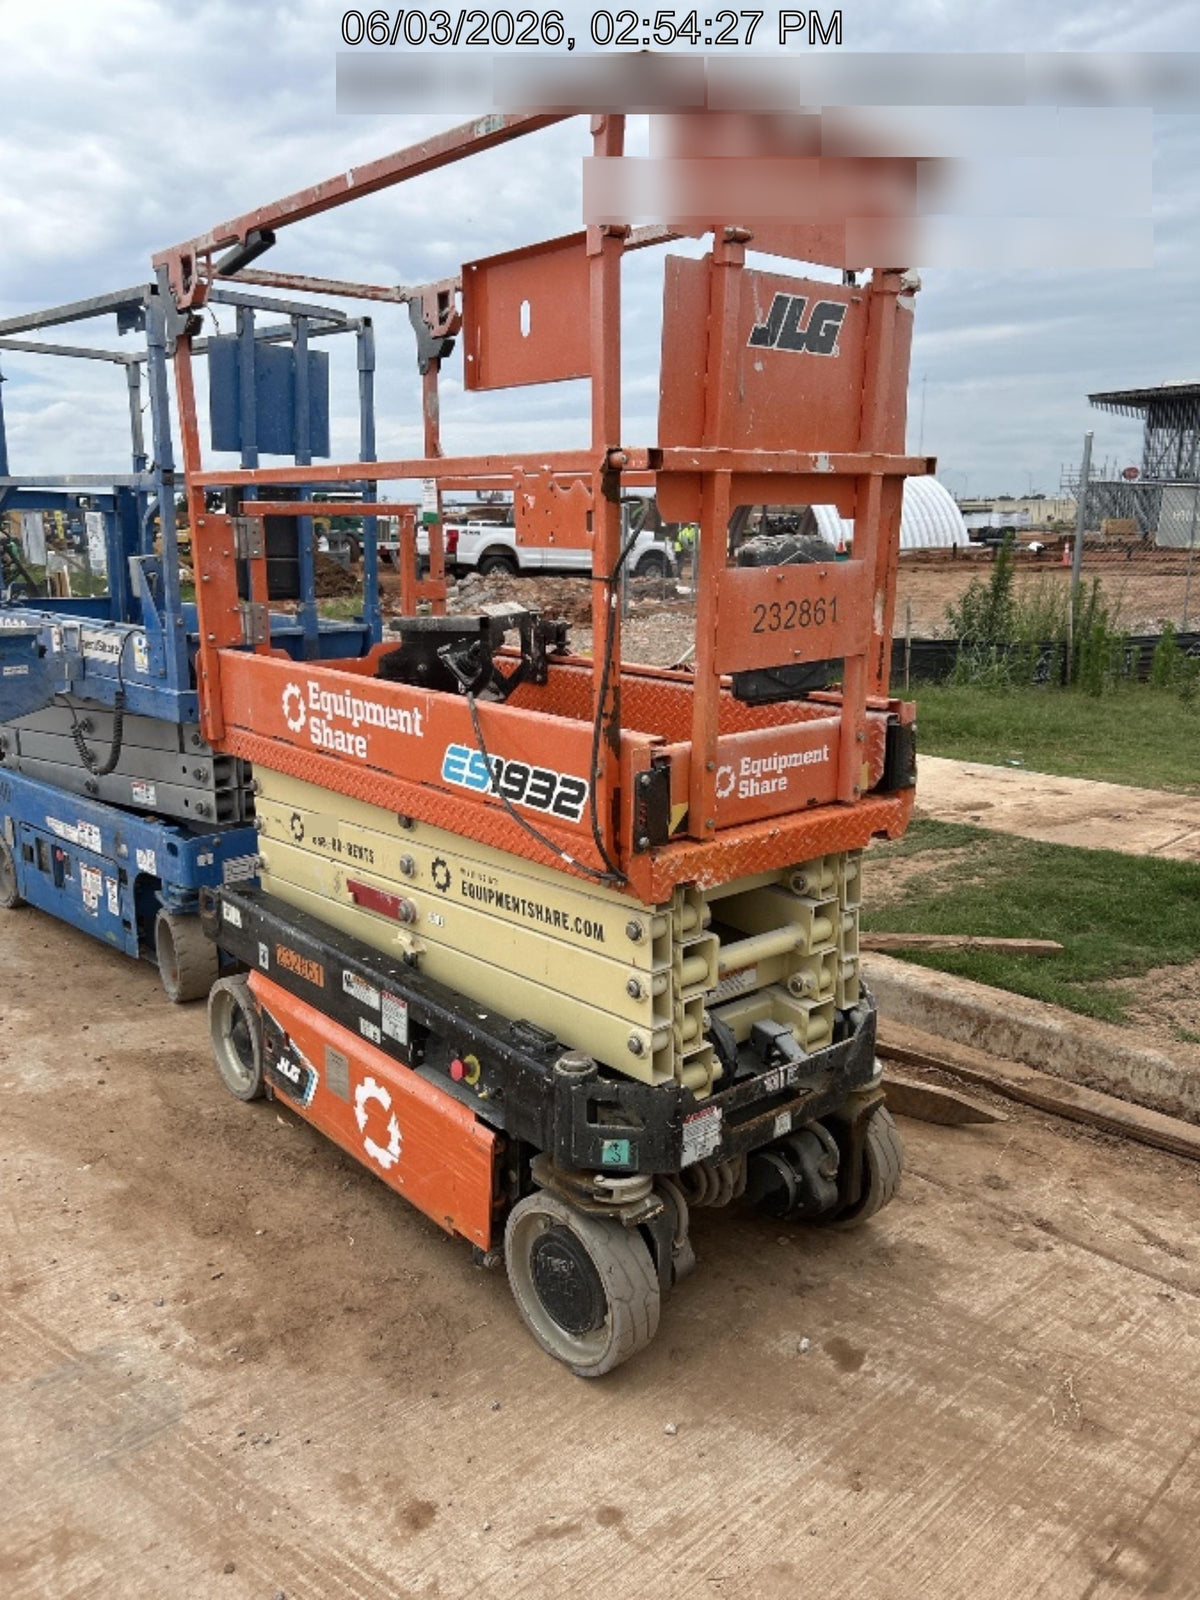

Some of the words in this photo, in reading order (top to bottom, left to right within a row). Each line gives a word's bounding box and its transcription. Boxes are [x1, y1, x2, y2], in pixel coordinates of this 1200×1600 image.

[746, 291, 849, 357] JLG
[752, 596, 837, 633] 232861
[306, 680, 424, 738] Equipment
[308, 715, 368, 758] Share
[739, 744, 830, 777] Equipment
[441, 744, 589, 822] ES1932
[738, 776, 788, 799] Share
[460, 879, 606, 943] EQUIPMENTSHARE.COM
[276, 1055, 302, 1084] JLG
